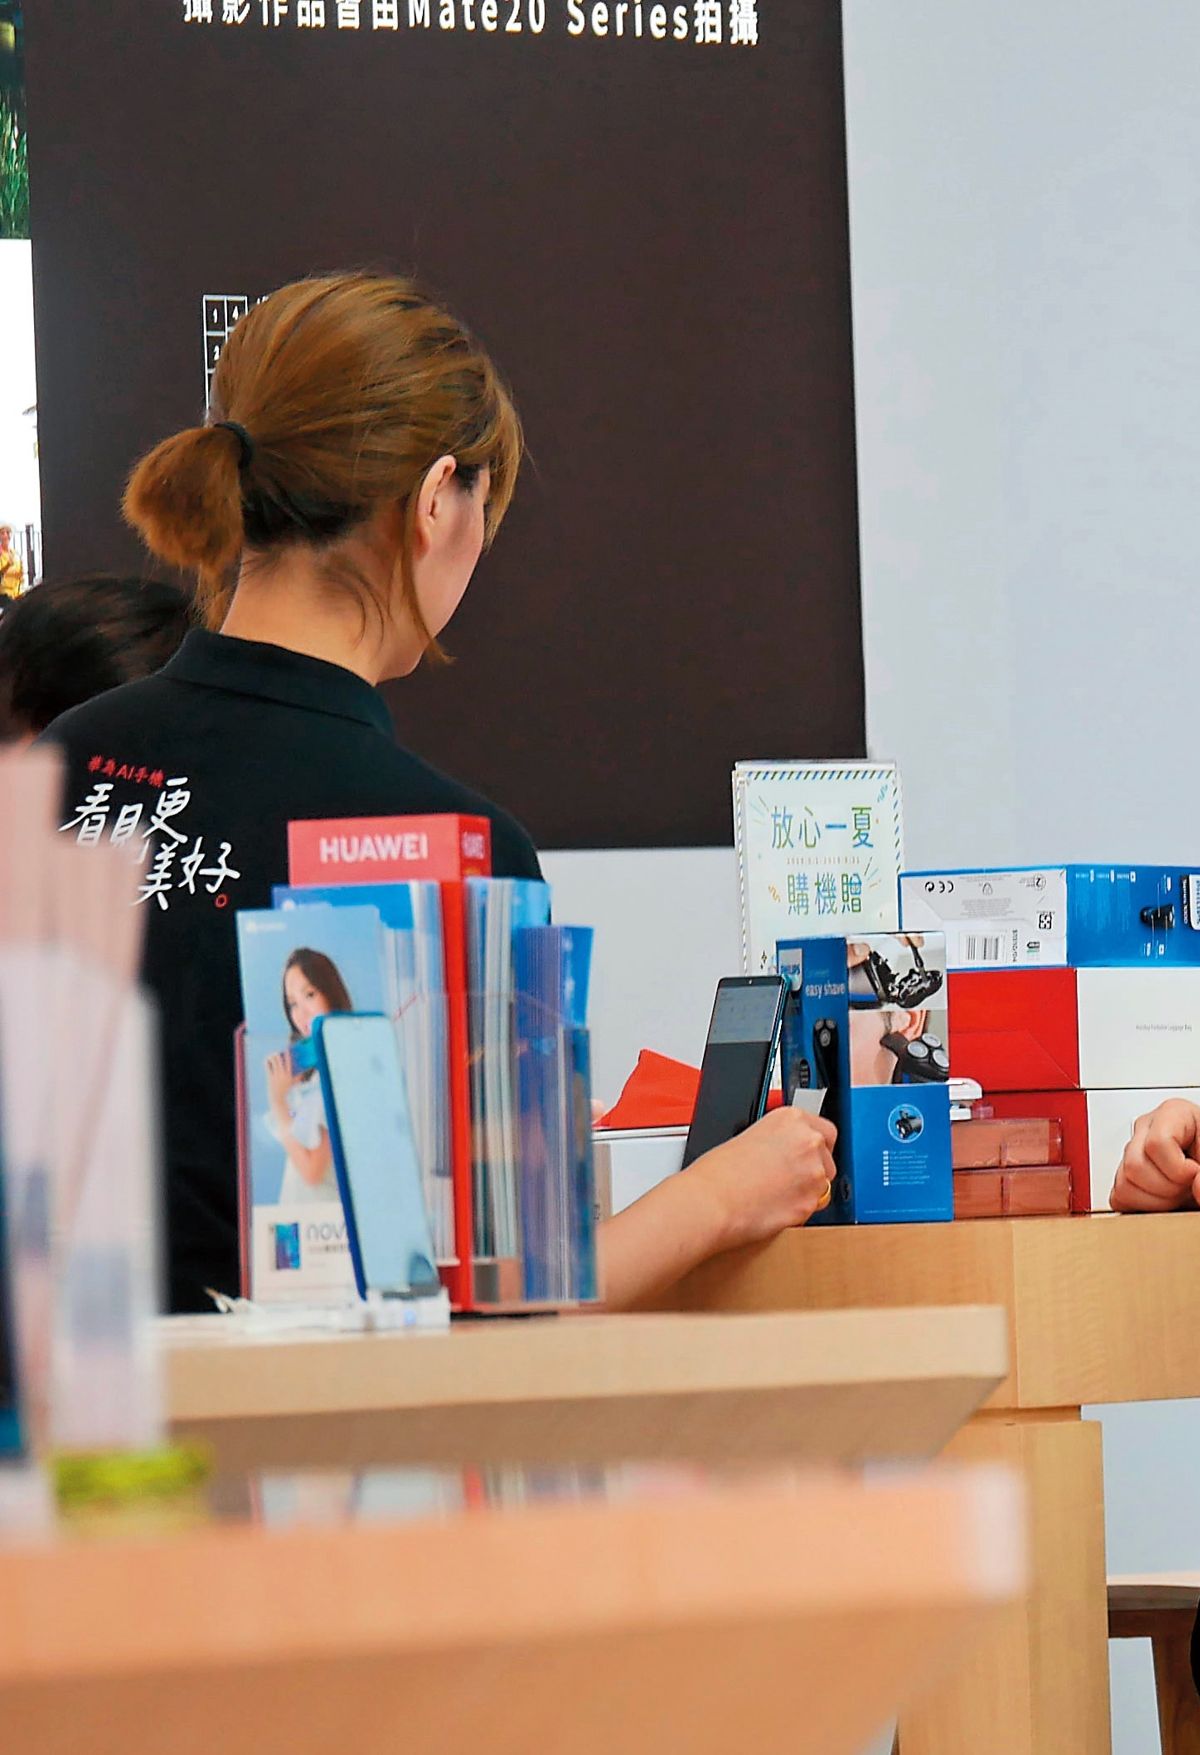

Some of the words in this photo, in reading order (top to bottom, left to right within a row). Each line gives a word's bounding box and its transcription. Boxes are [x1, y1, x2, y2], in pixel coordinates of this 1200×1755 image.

[771, 805, 874, 849] 放心一夏
[319, 833, 428, 864] HUAWEI
[787, 871, 862, 915] 購機贈
[805, 984, 823, 999] easy
[823, 980, 846, 996] shave
